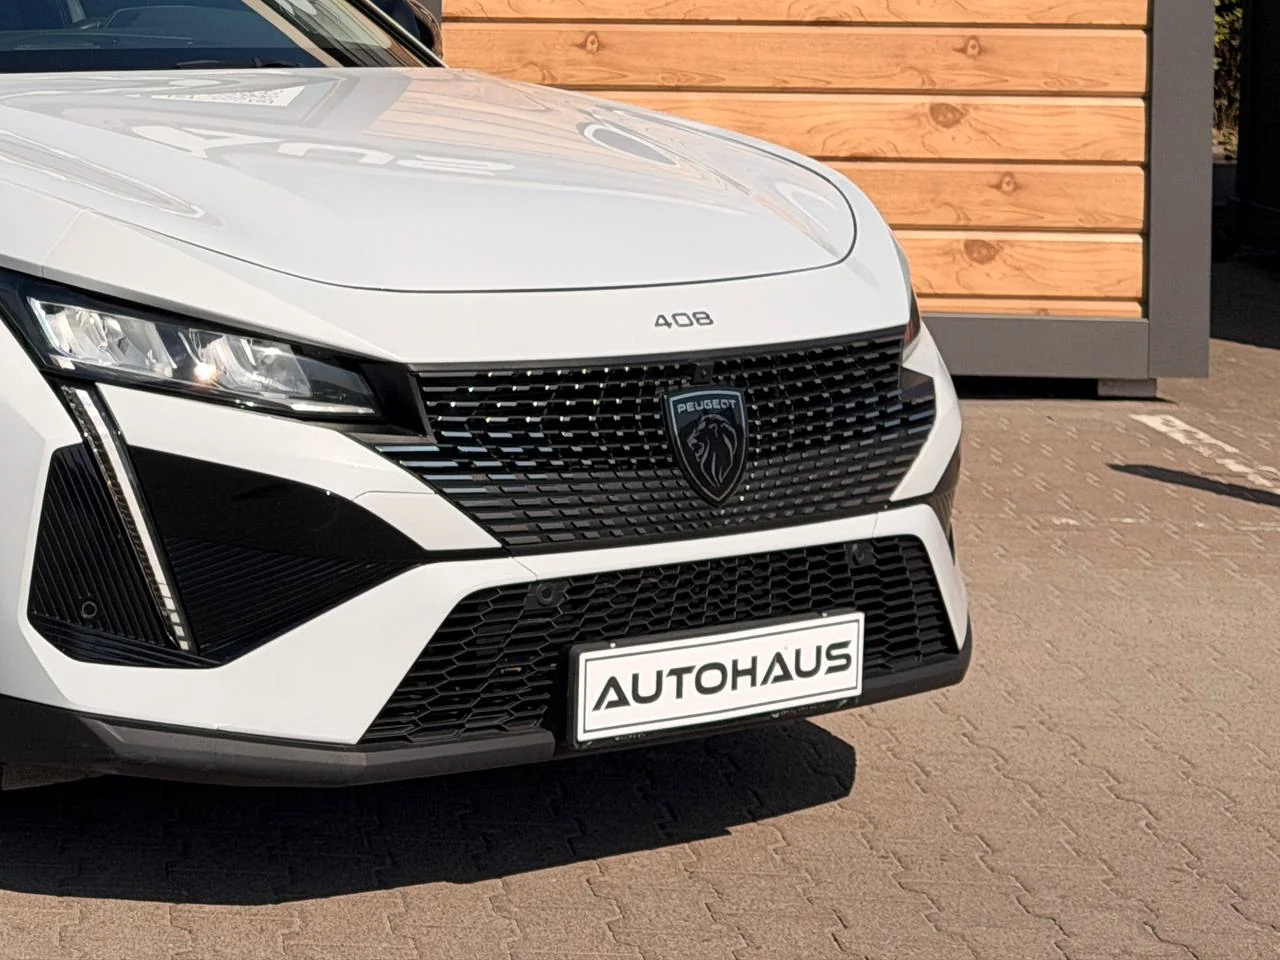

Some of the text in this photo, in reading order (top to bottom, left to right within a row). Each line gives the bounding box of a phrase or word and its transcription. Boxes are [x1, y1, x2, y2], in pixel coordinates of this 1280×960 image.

[654, 311, 714, 328] 408
[677, 399, 737, 414] PEUGEOT
[592, 640, 852, 712] AUTOHAUS
